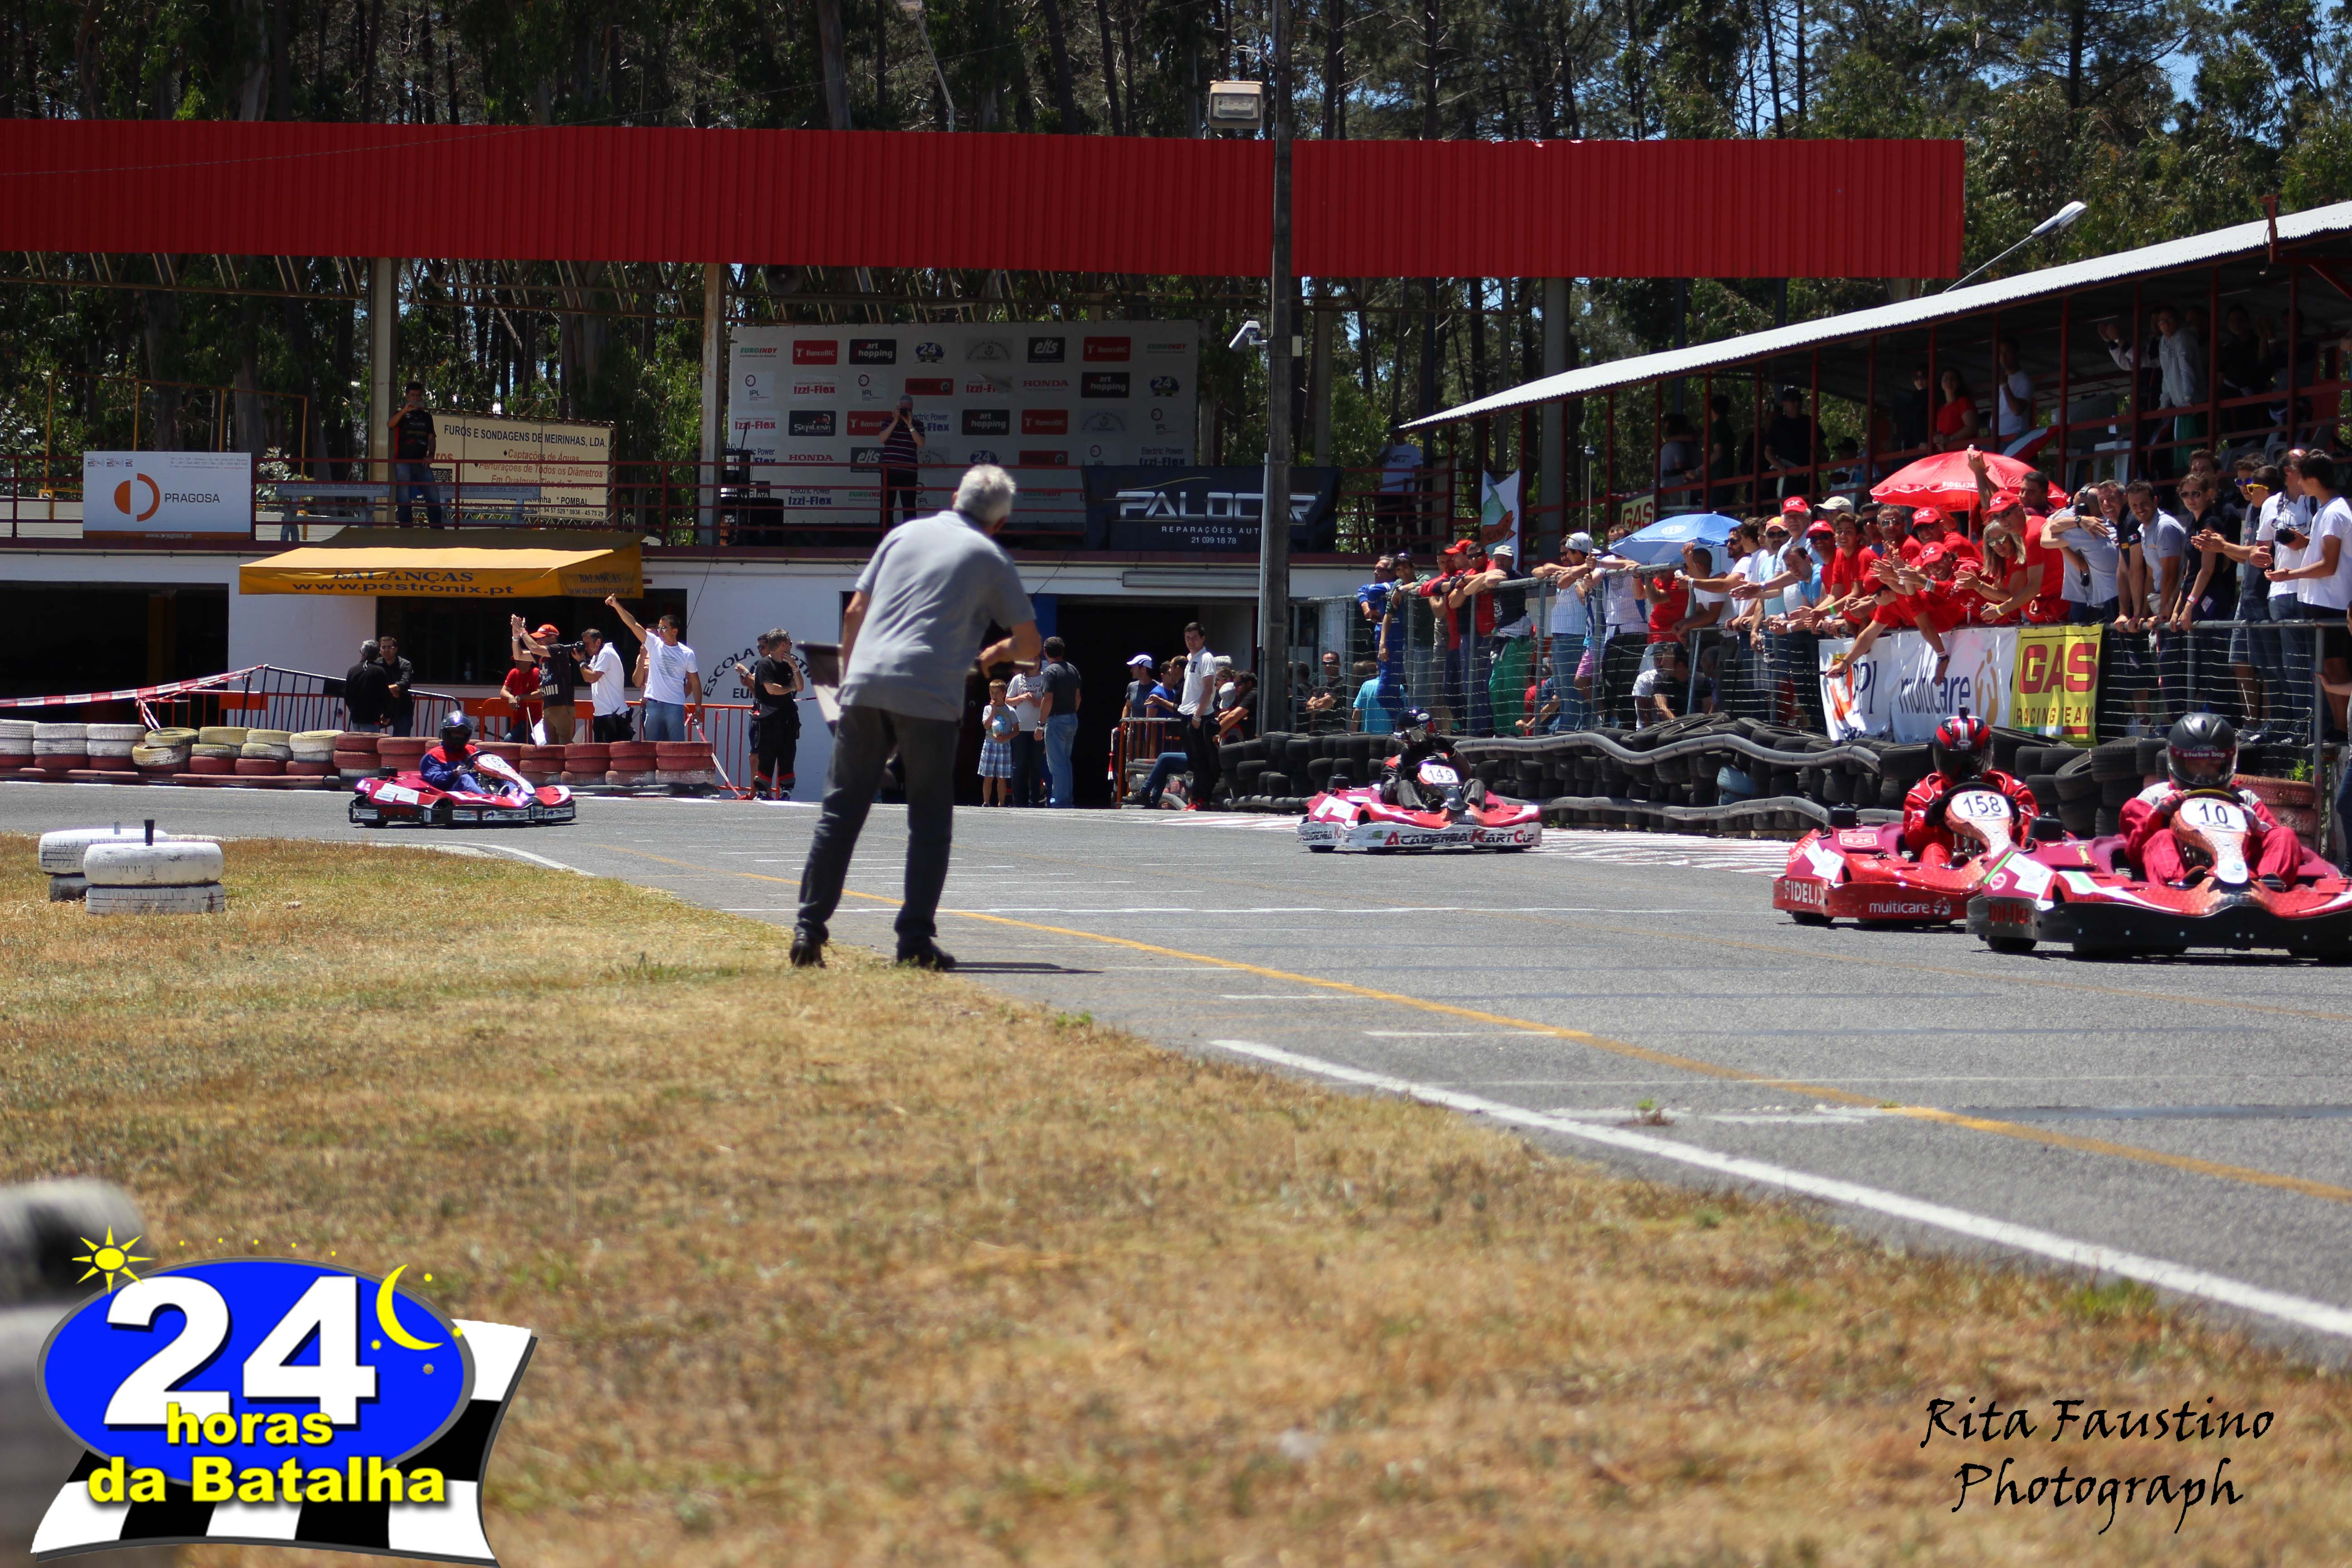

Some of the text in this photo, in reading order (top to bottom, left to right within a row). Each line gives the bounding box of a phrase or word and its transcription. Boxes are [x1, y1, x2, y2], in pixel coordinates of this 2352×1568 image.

[919, 344, 937, 355] 24
[1154, 377, 1172, 388] 24
[931, 412, 949, 421] Power
[444, 425, 607, 448] FUROS E SONDAGENS DE MEIRINHAS, LDA.
[508, 449, 546, 461] Captações
[547, 453, 556, 461] de
[524, 464, 533, 473] de
[535, 465, 556, 475] Todos
[568, 466, 603, 478] Diâmetros
[491, 475, 504, 483] Em
[165, 493, 220, 503] PRAGOSA
[560, 497, 589, 505] POMBAL
[1115, 491, 1317, 521] PALOCR
[1622, 501, 1653, 532] GAS
[1161, 525, 1261, 534] REPARAÇÕES AUT
[333, 571, 474, 584] BALANÇAS
[292, 582, 514, 596] www.pestronix.pt
[703, 647, 755, 698] ESCOLA
[2019, 642, 2097, 694] GAS
[1898, 674, 1970, 715] multicare
[2016, 706, 2093, 725] RACING TEAM
[1428, 769, 1454, 782] 149
[1963, 795, 2002, 814] 158
[2199, 803, 2229, 824] 10
[1869, 900, 1930, 914] multicare
